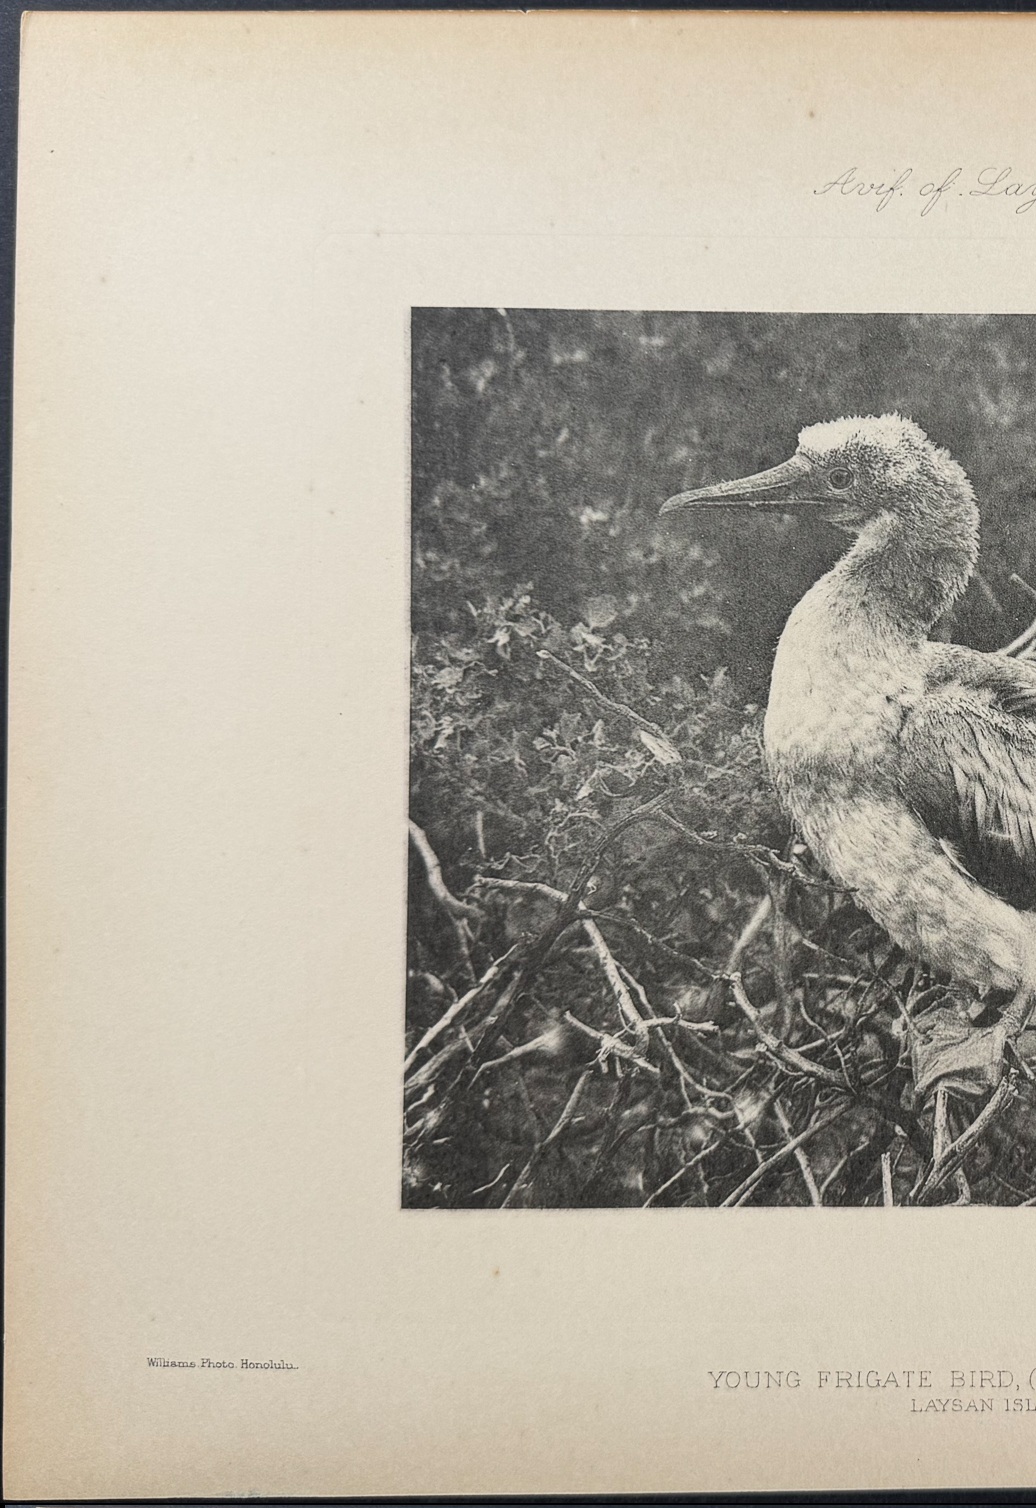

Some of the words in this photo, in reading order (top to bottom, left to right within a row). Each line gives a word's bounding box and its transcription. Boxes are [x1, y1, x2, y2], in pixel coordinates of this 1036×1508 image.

[813, 167, 913, 212] Avif.
[708, 1371, 801, 1389] YOUNG
[818, 1370, 932, 1388] FRIGATE
[950, 1370, 1021, 1391] BIRD,
[911, 1398, 995, 1412] LAYSAN
